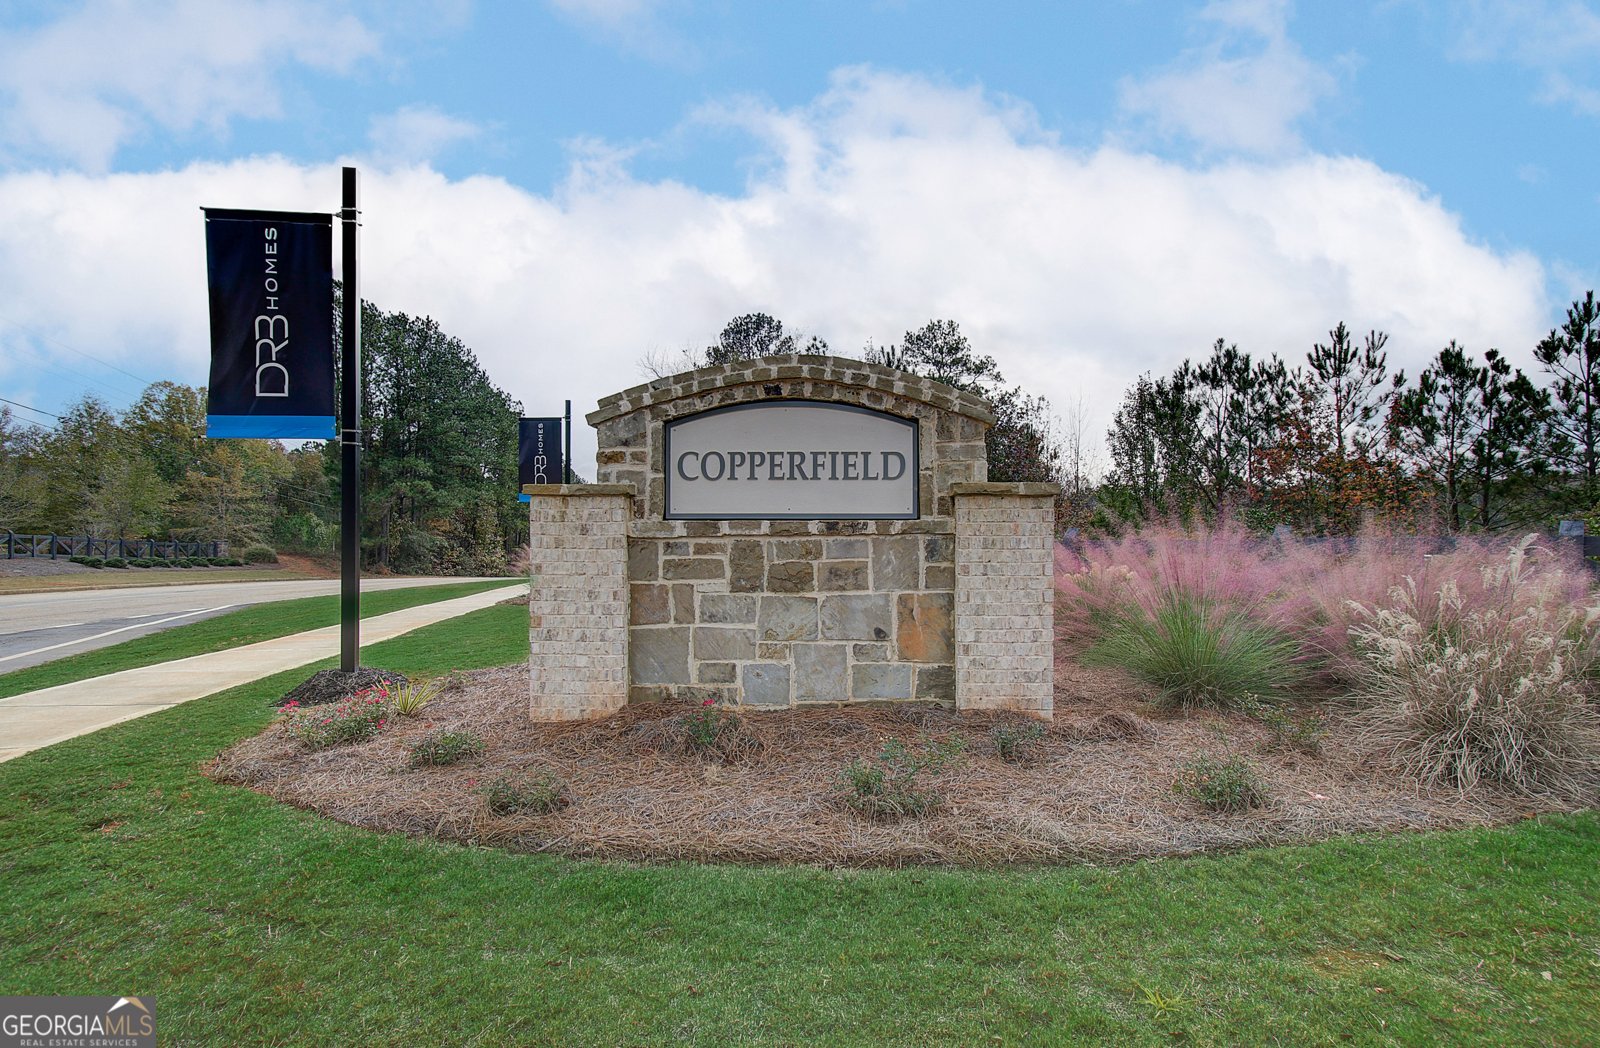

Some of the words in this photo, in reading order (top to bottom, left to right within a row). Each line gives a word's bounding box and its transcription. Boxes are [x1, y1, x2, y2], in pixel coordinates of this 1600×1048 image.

[264, 227, 279, 310] HOMES
[254, 314, 289, 397] DRB
[677, 451, 906, 482] COPPERFIELD
